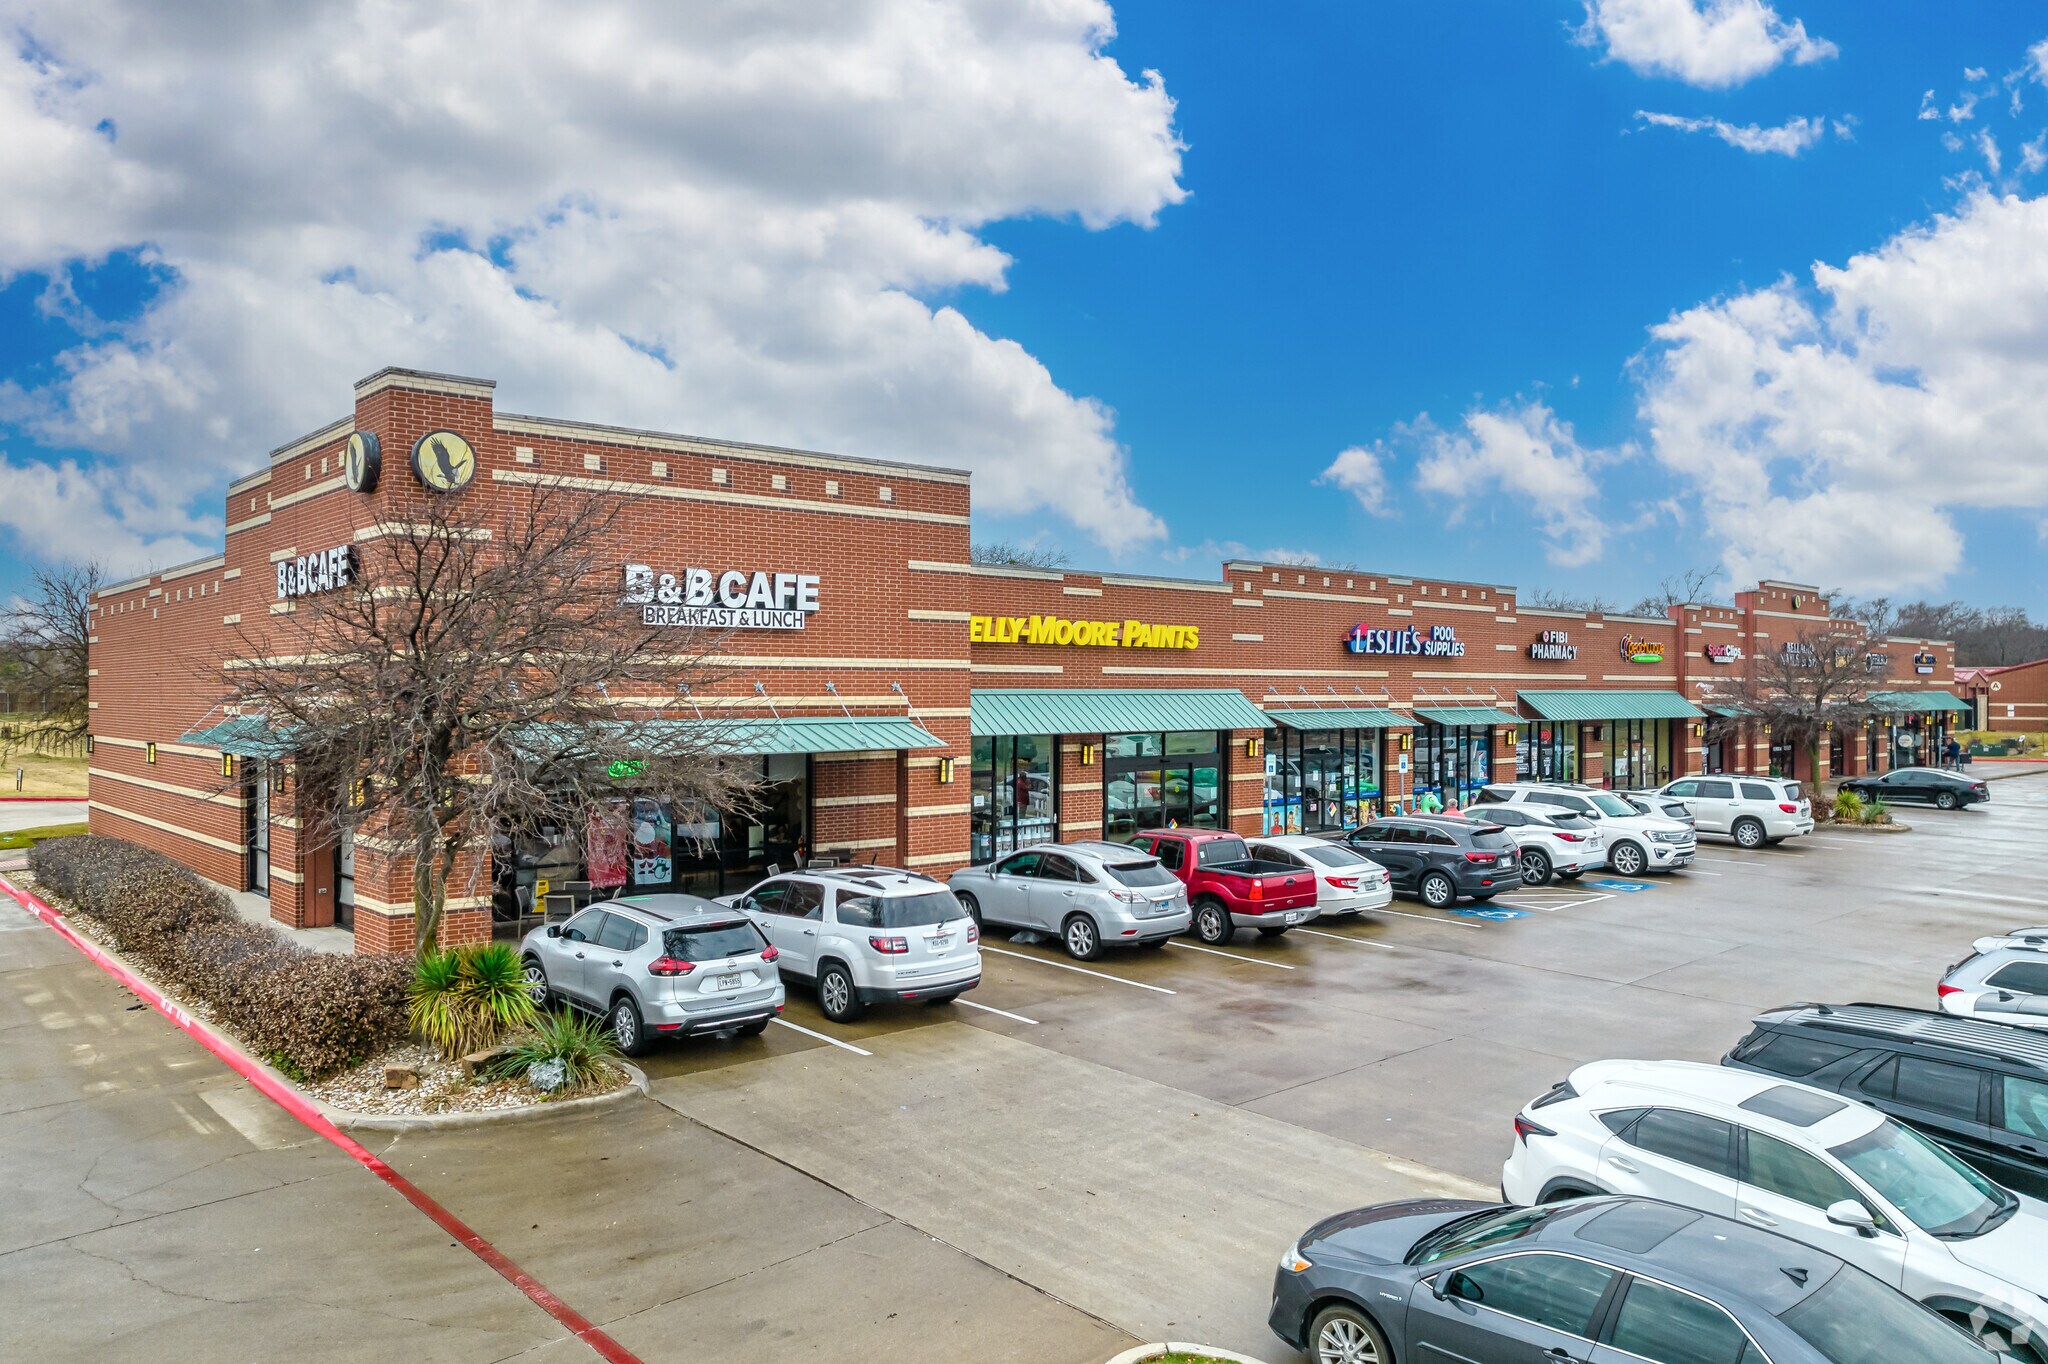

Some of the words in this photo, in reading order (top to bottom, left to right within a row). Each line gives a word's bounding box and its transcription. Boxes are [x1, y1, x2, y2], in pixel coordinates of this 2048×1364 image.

[277, 556, 308, 598] B&B
[308, 545, 348, 593] CAFE
[626, 565, 714, 606] B&B
[719, 570, 820, 611] CAFE
[645, 607, 735, 626] BREAKFAST
[739, 612, 750, 626] &
[753, 611, 803, 628] LUNCH
[970, 615, 1120, 647] ELLY-MOORE
[1122, 620, 1199, 649] PAINTS
[1355, 625, 1421, 654] LESLIE'S
[1433, 626, 1456, 641] POOL
[1550, 631, 1568, 643] FIBI
[1424, 641, 1465, 656] SUPPLIES
[1532, 644, 1578, 659] PHARMACY
